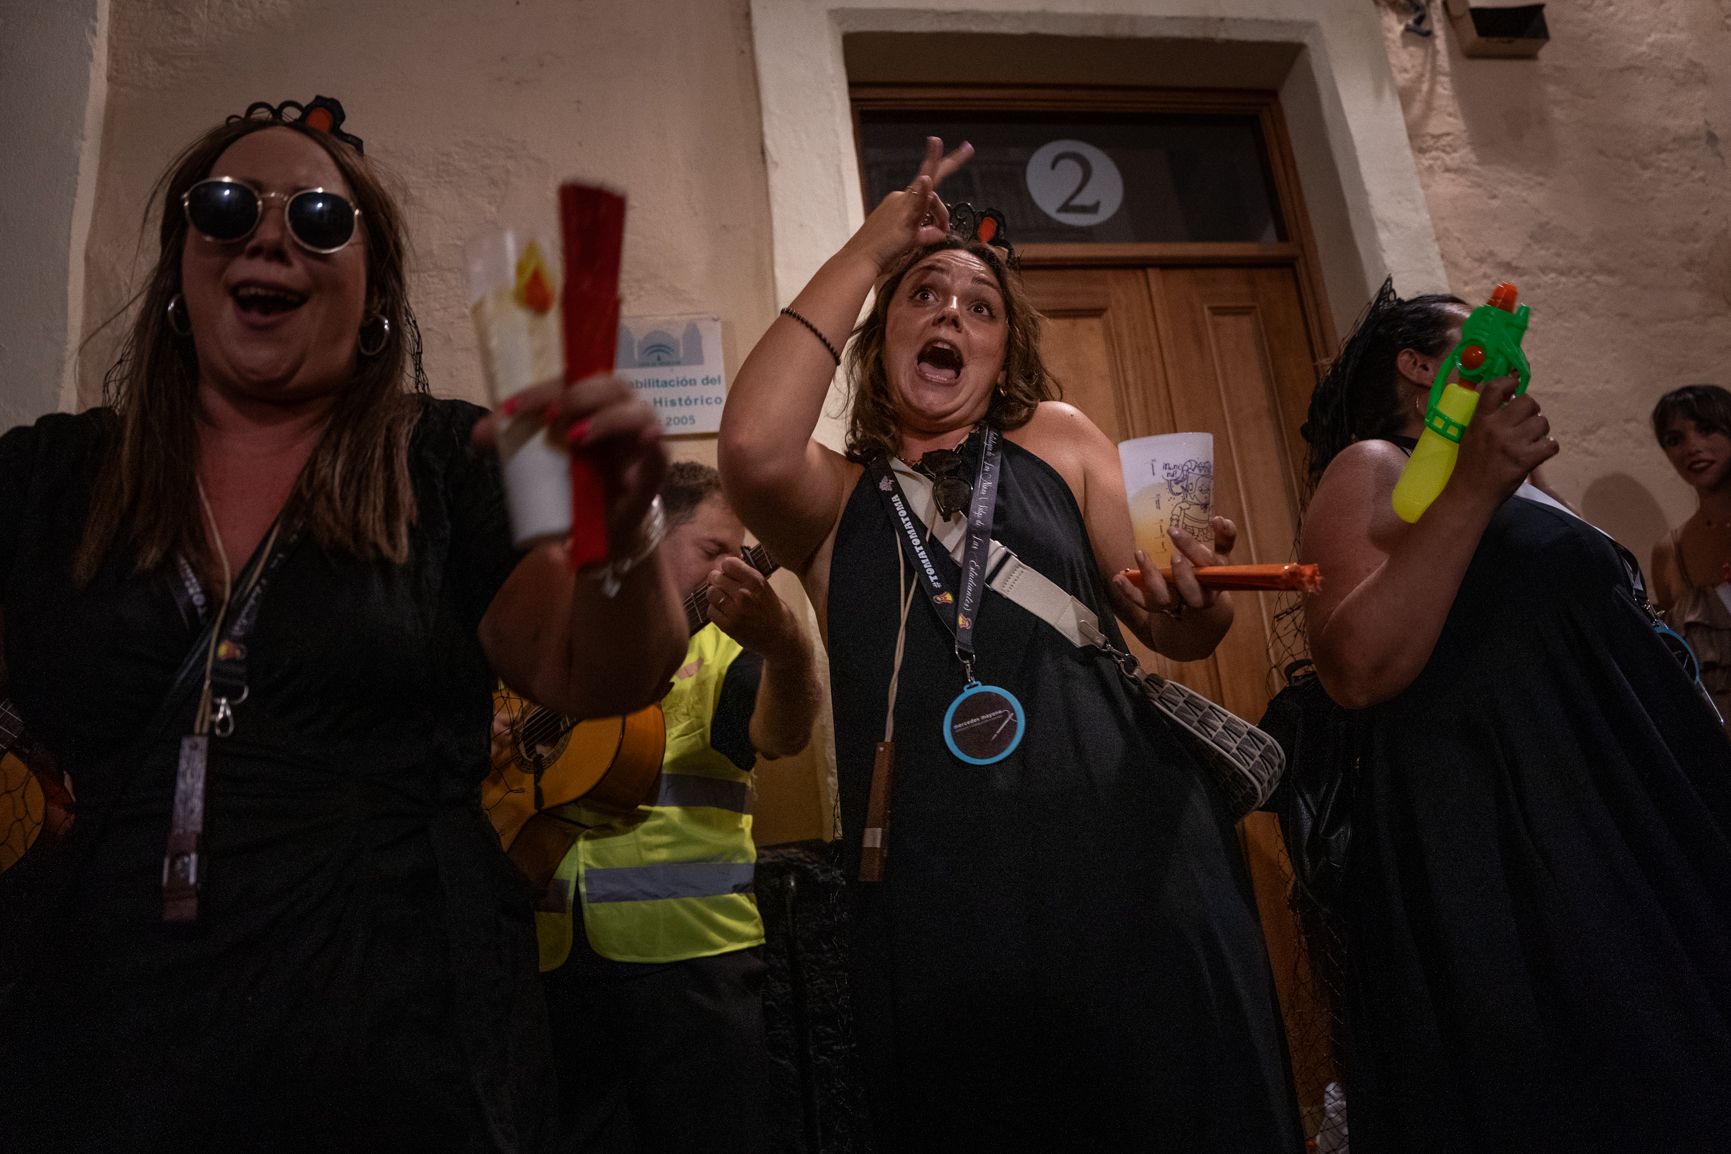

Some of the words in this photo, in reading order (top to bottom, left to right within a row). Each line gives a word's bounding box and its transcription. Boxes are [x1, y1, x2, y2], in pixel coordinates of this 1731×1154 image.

[1050, 150, 1101, 214] 2
[628, 375, 697, 389] abilitación
[701, 374, 721, 386] del
[653, 396, 723, 408] Histórico
[665, 415, 696, 426] 2005
[891, 494, 942, 588] #TOMATOMATOMA
